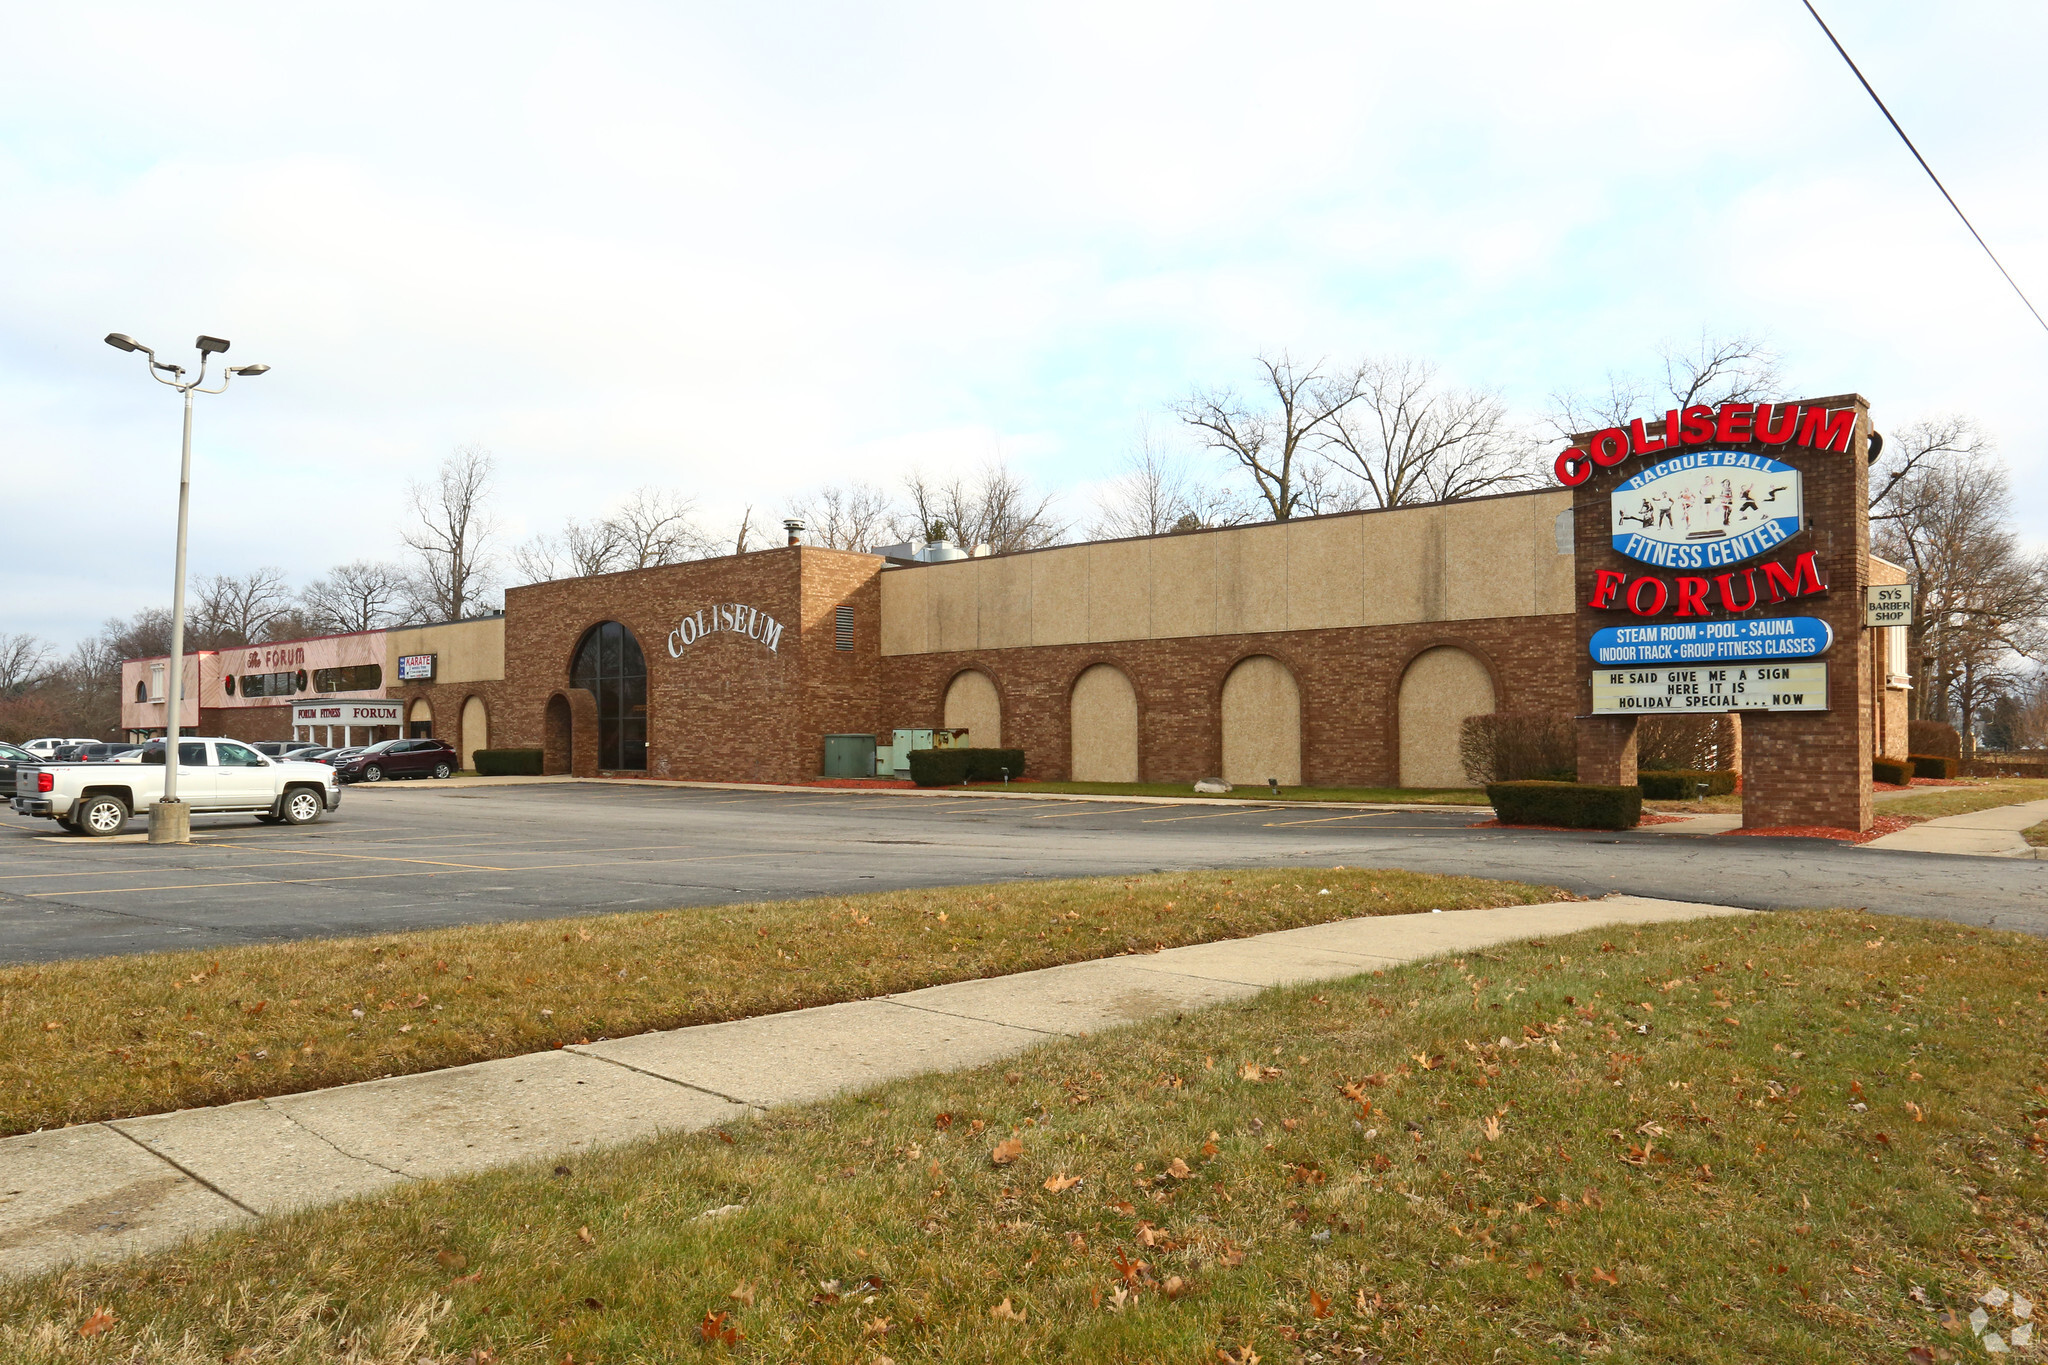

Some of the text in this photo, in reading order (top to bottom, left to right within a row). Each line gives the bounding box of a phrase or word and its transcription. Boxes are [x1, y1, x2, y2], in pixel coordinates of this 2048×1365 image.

[1554, 403, 1858, 487] COLISEUM
[1629, 452, 1774, 490] RACQUETBALL
[1624, 519, 1787, 568] FITNESS CENTER
[1588, 550, 1828, 617] FORUM
[1879, 588, 1902, 600] SY'S
[1869, 602, 1911, 611] BARBER
[1875, 611, 1904, 621] SHOP
[667, 602, 784, 659] COLISEUM
[1616, 619, 1795, 643] STEAM ROOM POOL SAUNA
[265, 647, 305, 668] FORUM
[1599, 637, 1816, 662] INDOOR TRACK GROUP FITNESS CLASSES
[406, 655, 431, 667] KARATE
[1610, 668, 1790, 684] HE SAID GIVE ME A SIGN
[1667, 682, 1745, 695] HERE IT IS
[1619, 696, 1672, 708] HOLIDAY
[1685, 695, 1738, 707] SPECIAL
[1772, 694, 1804, 705] NOW
[353, 707, 397, 719] FORUM
